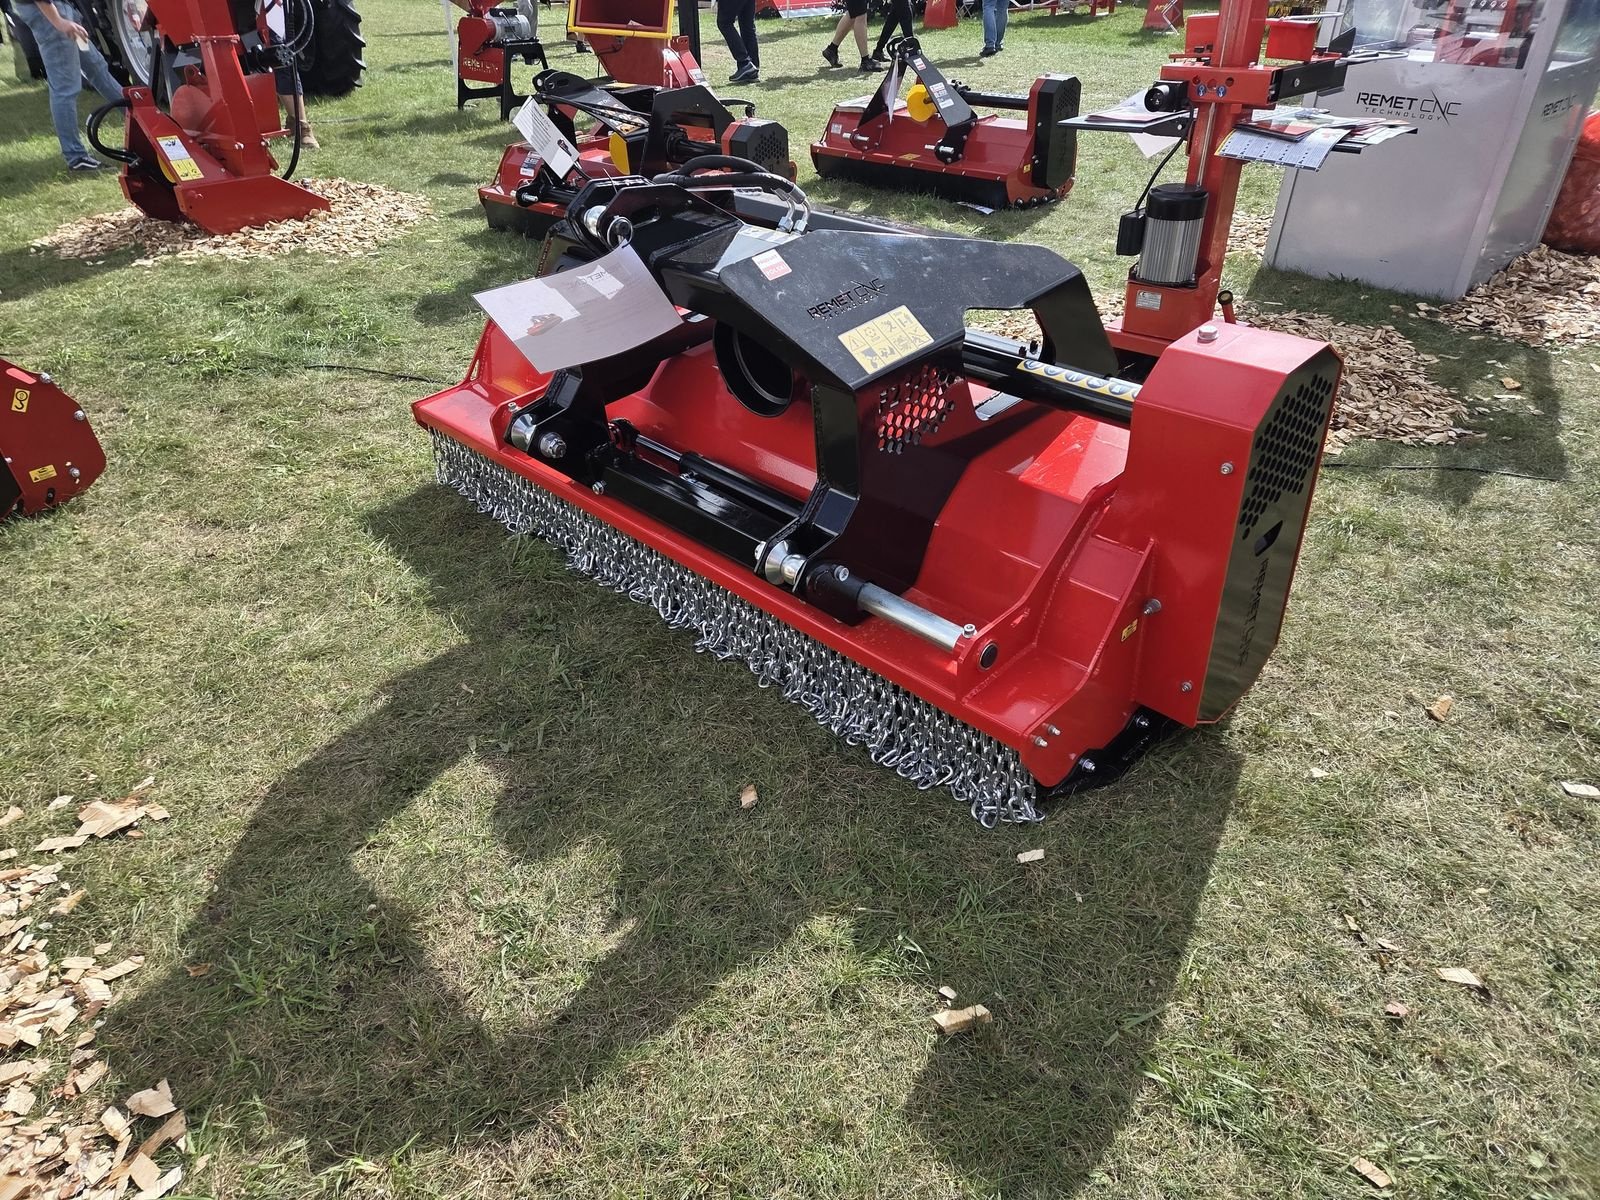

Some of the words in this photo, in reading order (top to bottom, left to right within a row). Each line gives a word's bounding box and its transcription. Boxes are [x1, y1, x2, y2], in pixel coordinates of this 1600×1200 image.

[1356, 92, 1419, 110] REMET
[1420, 92, 1462, 121] CNC
[1365, 107, 1441, 121] TECHNOLOGY
[806, 291, 855, 319] REMET
[851, 278, 887, 298] CNC
